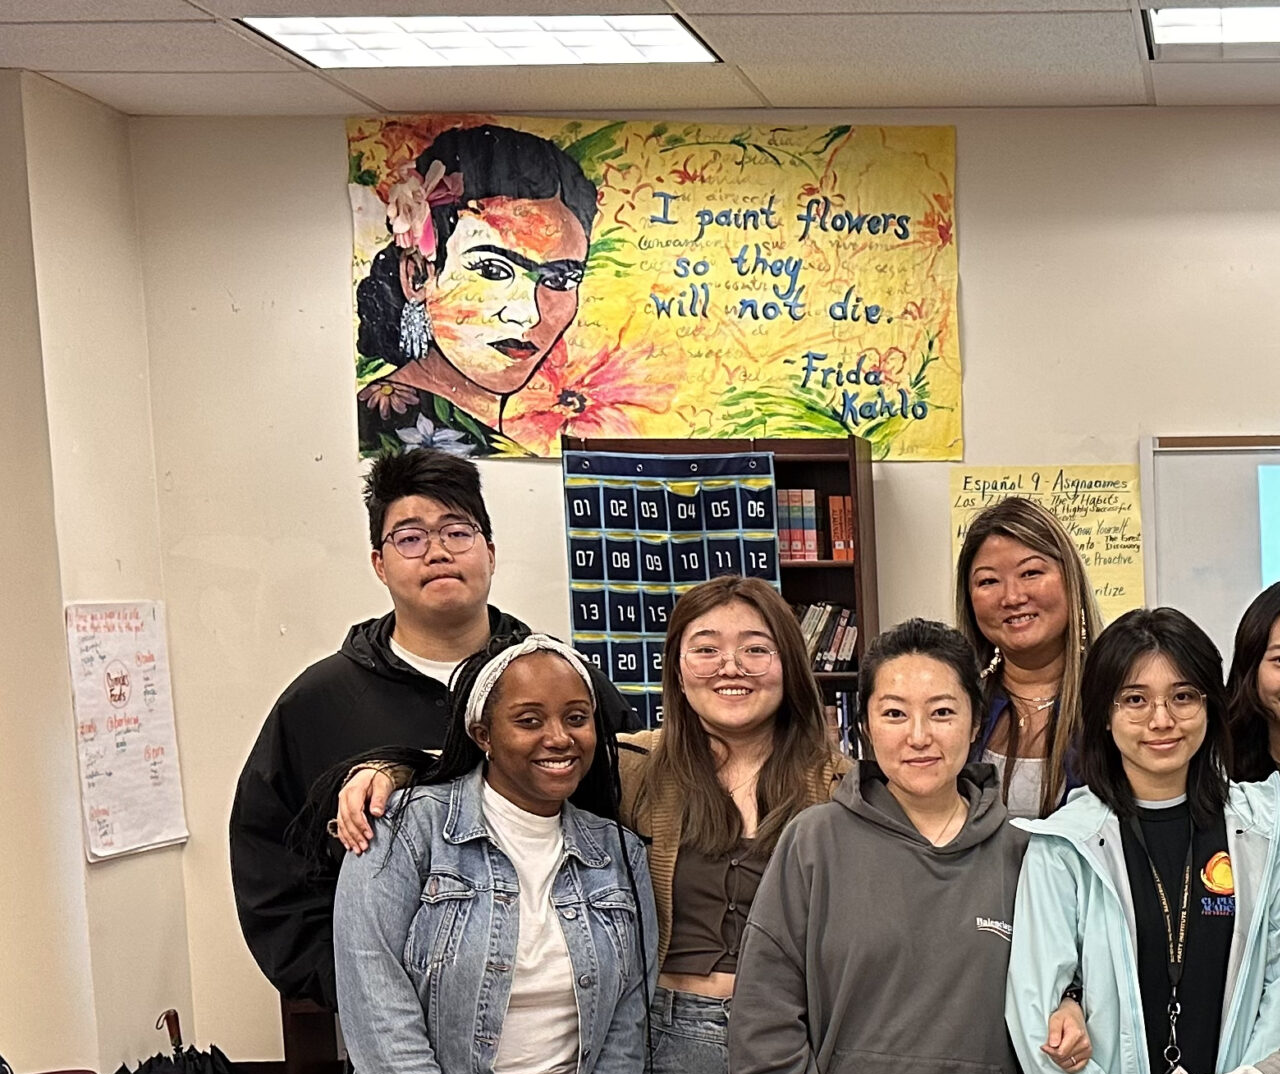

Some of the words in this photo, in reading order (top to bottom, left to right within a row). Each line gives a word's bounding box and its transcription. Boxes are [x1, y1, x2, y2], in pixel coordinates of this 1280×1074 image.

[650, 191, 682, 225] I
[695, 194, 779, 242] paint
[797, 197, 910, 241] flowers
[674, 257, 710, 279] so
[731, 244, 803, 300] they
[650, 283, 710, 319] will
[739, 284, 806, 321] not
[829, 284, 894, 324] die.
[841, 389, 928, 426] Kahlo
[963, 474, 1024, 501] Español
[1031, 472, 1041, 491] 9
[573, 499, 592, 517] 01
[610, 499, 628, 517] 02
[641, 501, 659, 518] 03
[677, 503, 696, 520] 04
[711, 500, 730, 518] 05
[747, 500, 766, 518] 06
[954, 495, 976, 508] Los
[1080, 493, 1119, 506] Habits
[1062, 503, 1088, 517] Highly
[576, 550, 594, 568] 07
[612, 551, 630, 569] 08
[645, 554, 663, 572] 09
[681, 552, 699, 570] 10
[715, 551, 733, 568] 11
[750, 552, 768, 570] 12
[1093, 551, 1134, 566] Proactive
[1095, 582, 1126, 597] ritize
[580, 603, 599, 621] 13
[618, 604, 636, 623] 14
[649, 605, 667, 623] 15
[618, 653, 636, 670] 20
